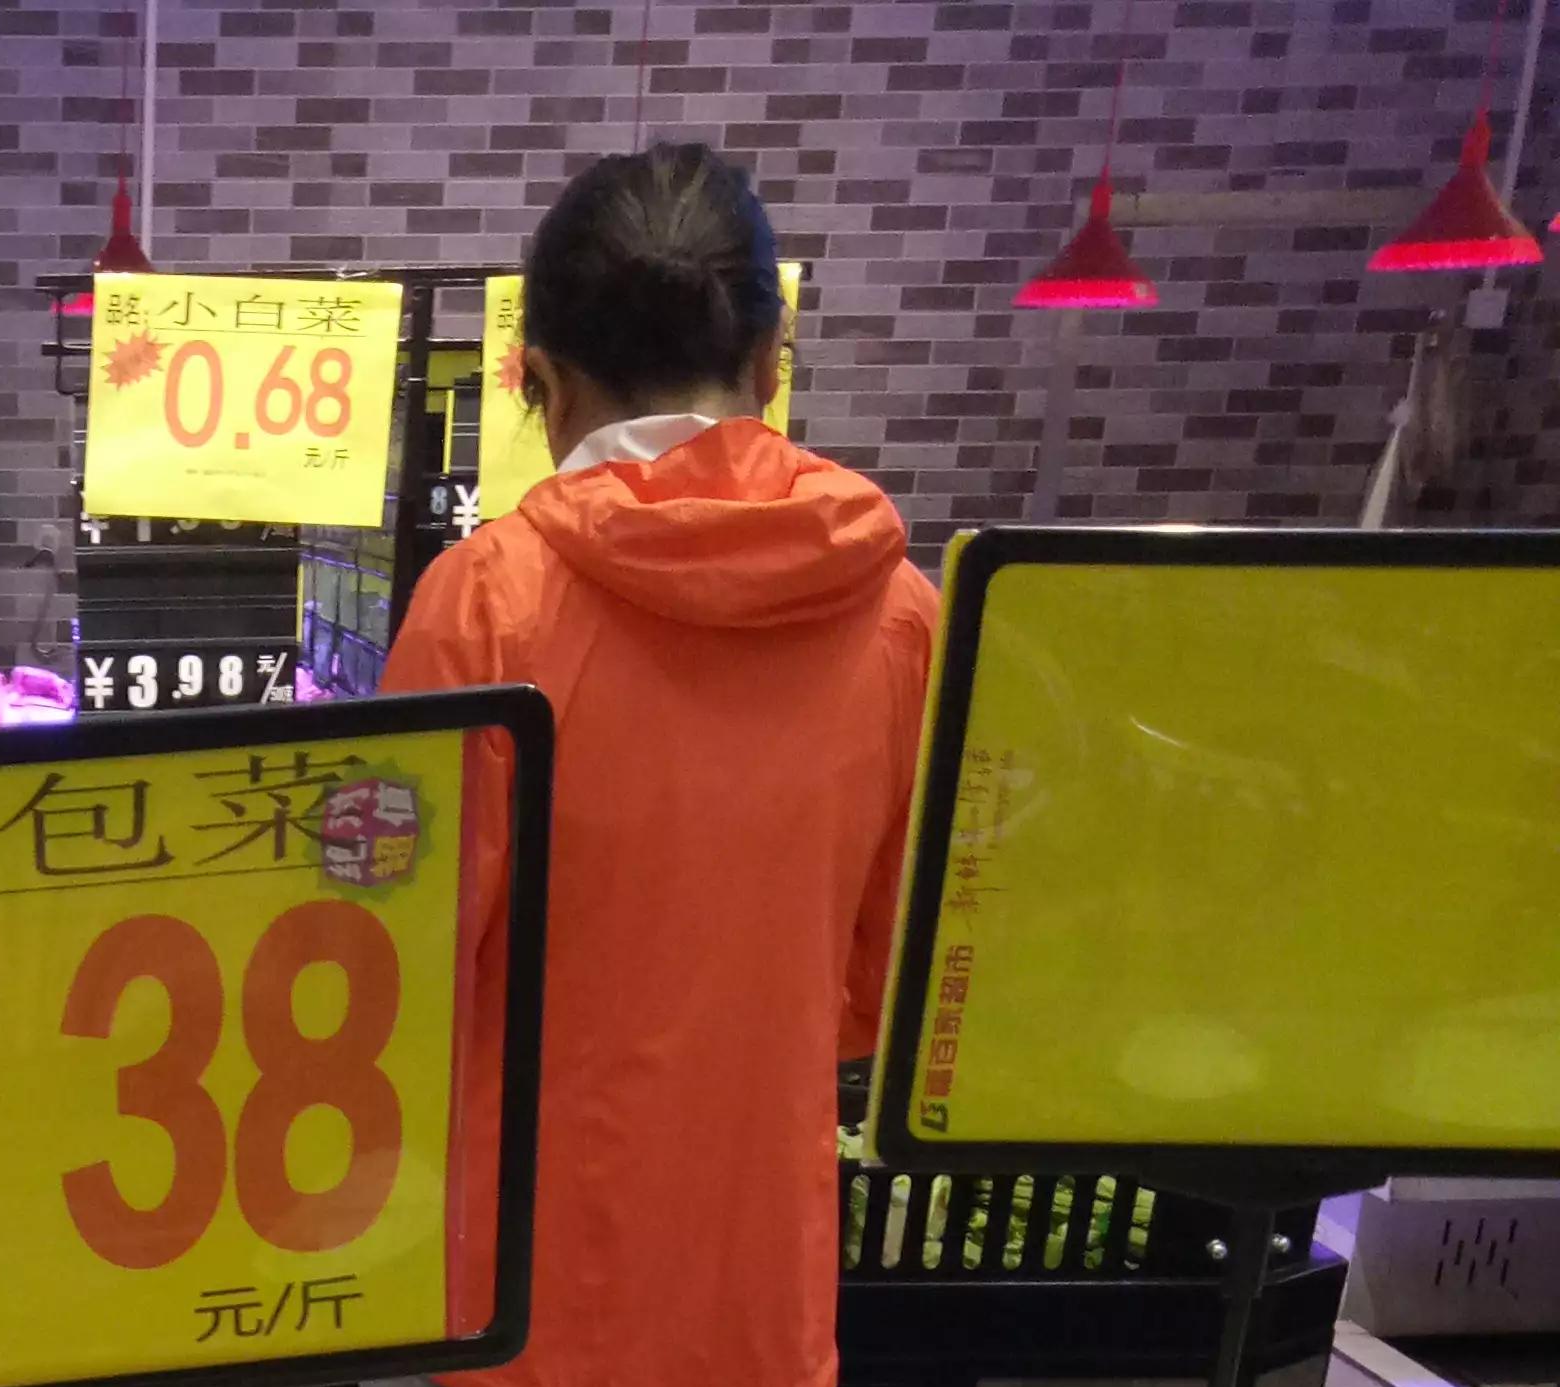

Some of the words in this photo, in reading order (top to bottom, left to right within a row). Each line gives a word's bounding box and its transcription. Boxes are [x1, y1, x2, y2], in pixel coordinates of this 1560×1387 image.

[156, 290, 363, 332] 小白菜
[164, 338, 353, 450] 0.68
[194, 1274, 365, 1342] 元/斤
